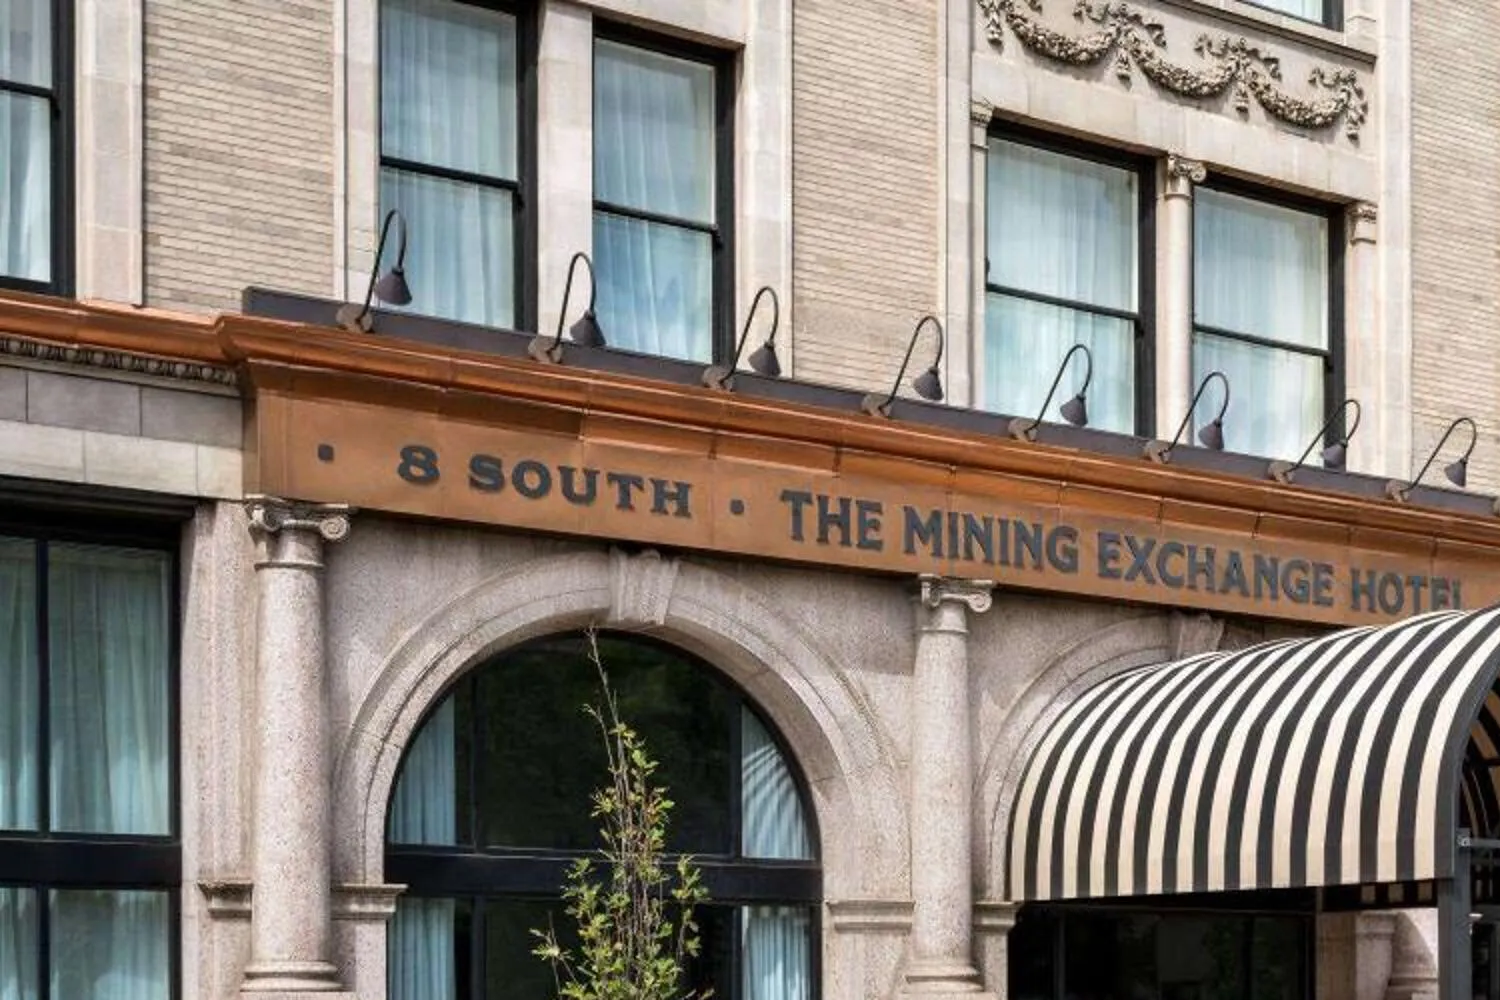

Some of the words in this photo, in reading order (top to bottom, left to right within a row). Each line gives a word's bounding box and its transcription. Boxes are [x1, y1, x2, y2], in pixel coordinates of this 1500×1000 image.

[397, 445, 440, 485] 8
[468, 454, 693, 518] SOUTH
[781, 489, 884, 552] THE
[903, 505, 1079, 573] MINING
[1097, 531, 1335, 607] EXCHANGE
